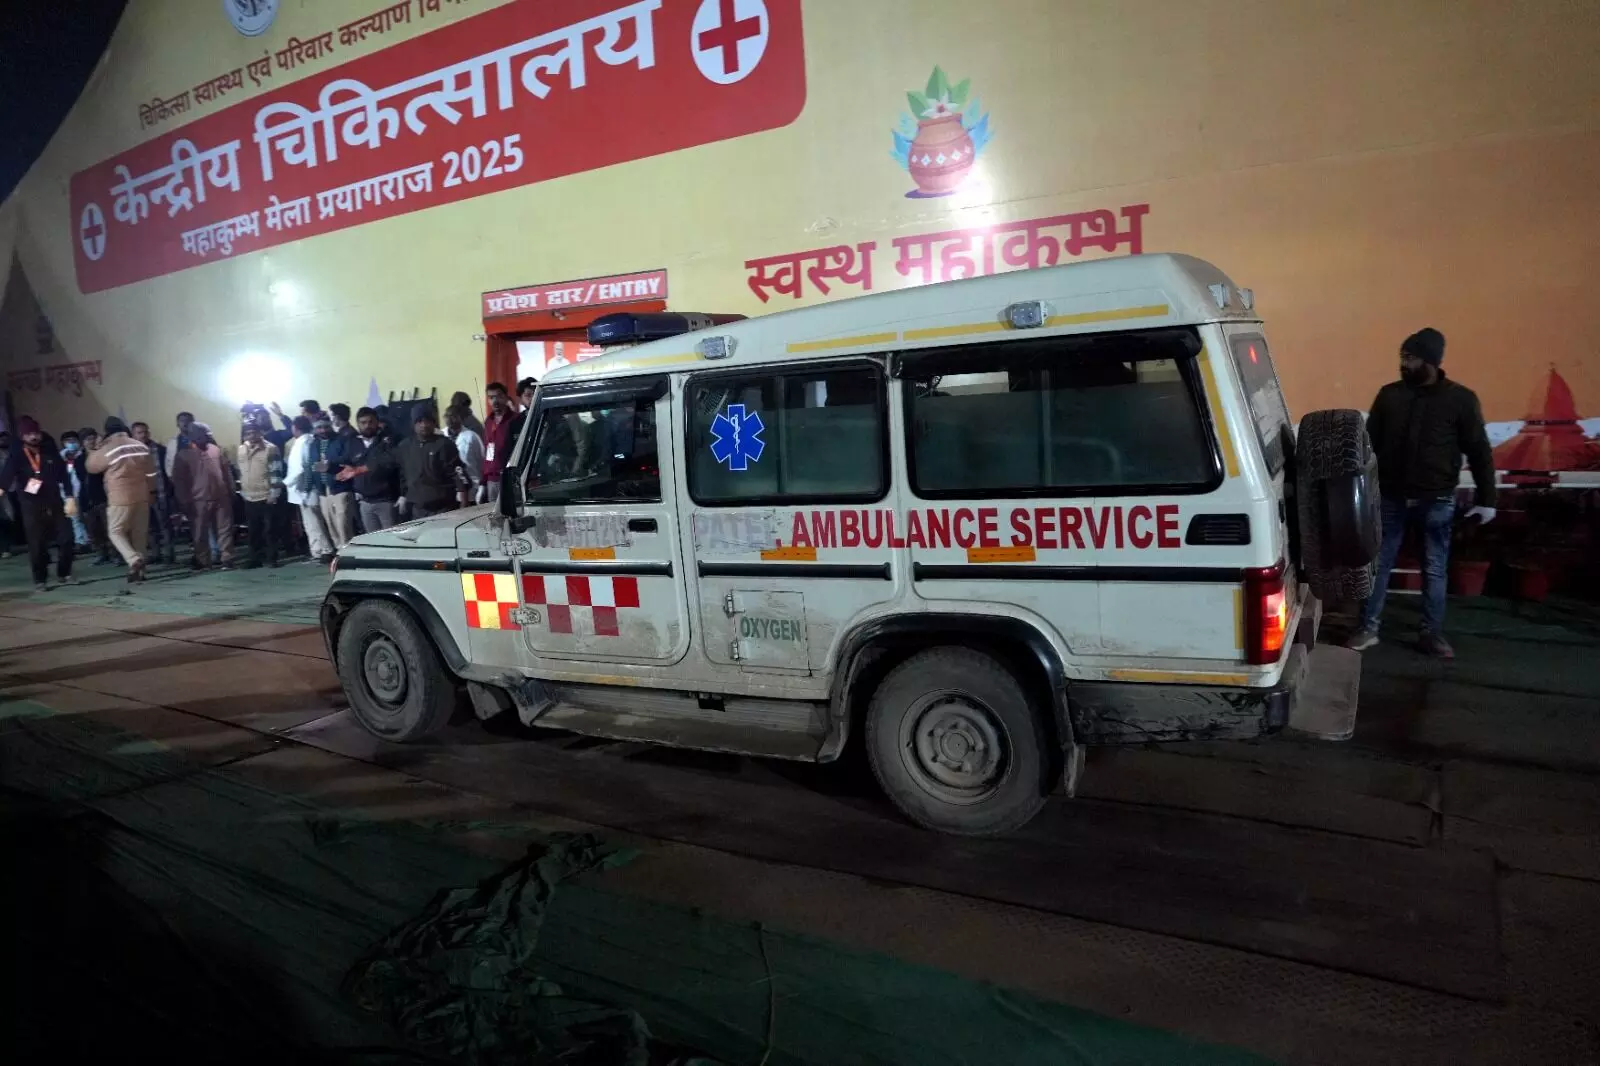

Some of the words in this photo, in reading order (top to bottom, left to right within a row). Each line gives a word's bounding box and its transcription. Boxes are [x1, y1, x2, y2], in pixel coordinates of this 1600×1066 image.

[138, 91, 191, 130] चिकित्सा
[193, 68, 244, 104] स्वास्थ्य
[246, 49, 272, 87] एवं
[275, 31, 333, 70] परिवार
[338, 0, 412, 46] कल्याण
[109, 138, 241, 224] केन्द्रीय
[253, 0, 662, 182] चिकित्सालय
[180, 211, 260, 256] महाकुम्भ
[264, 195, 311, 231] मेला
[316, 161, 434, 220] प्रयागराज
[441, 133, 524, 188] 2025
[486, 292, 539, 314] प्रवेश
[744, 241, 877, 304] स्वस्थ
[791, 507, 1000, 549] AMBULANCE
[1010, 504, 1181, 550] SERVICE
[740, 616, 802, 642] OXYGEN
